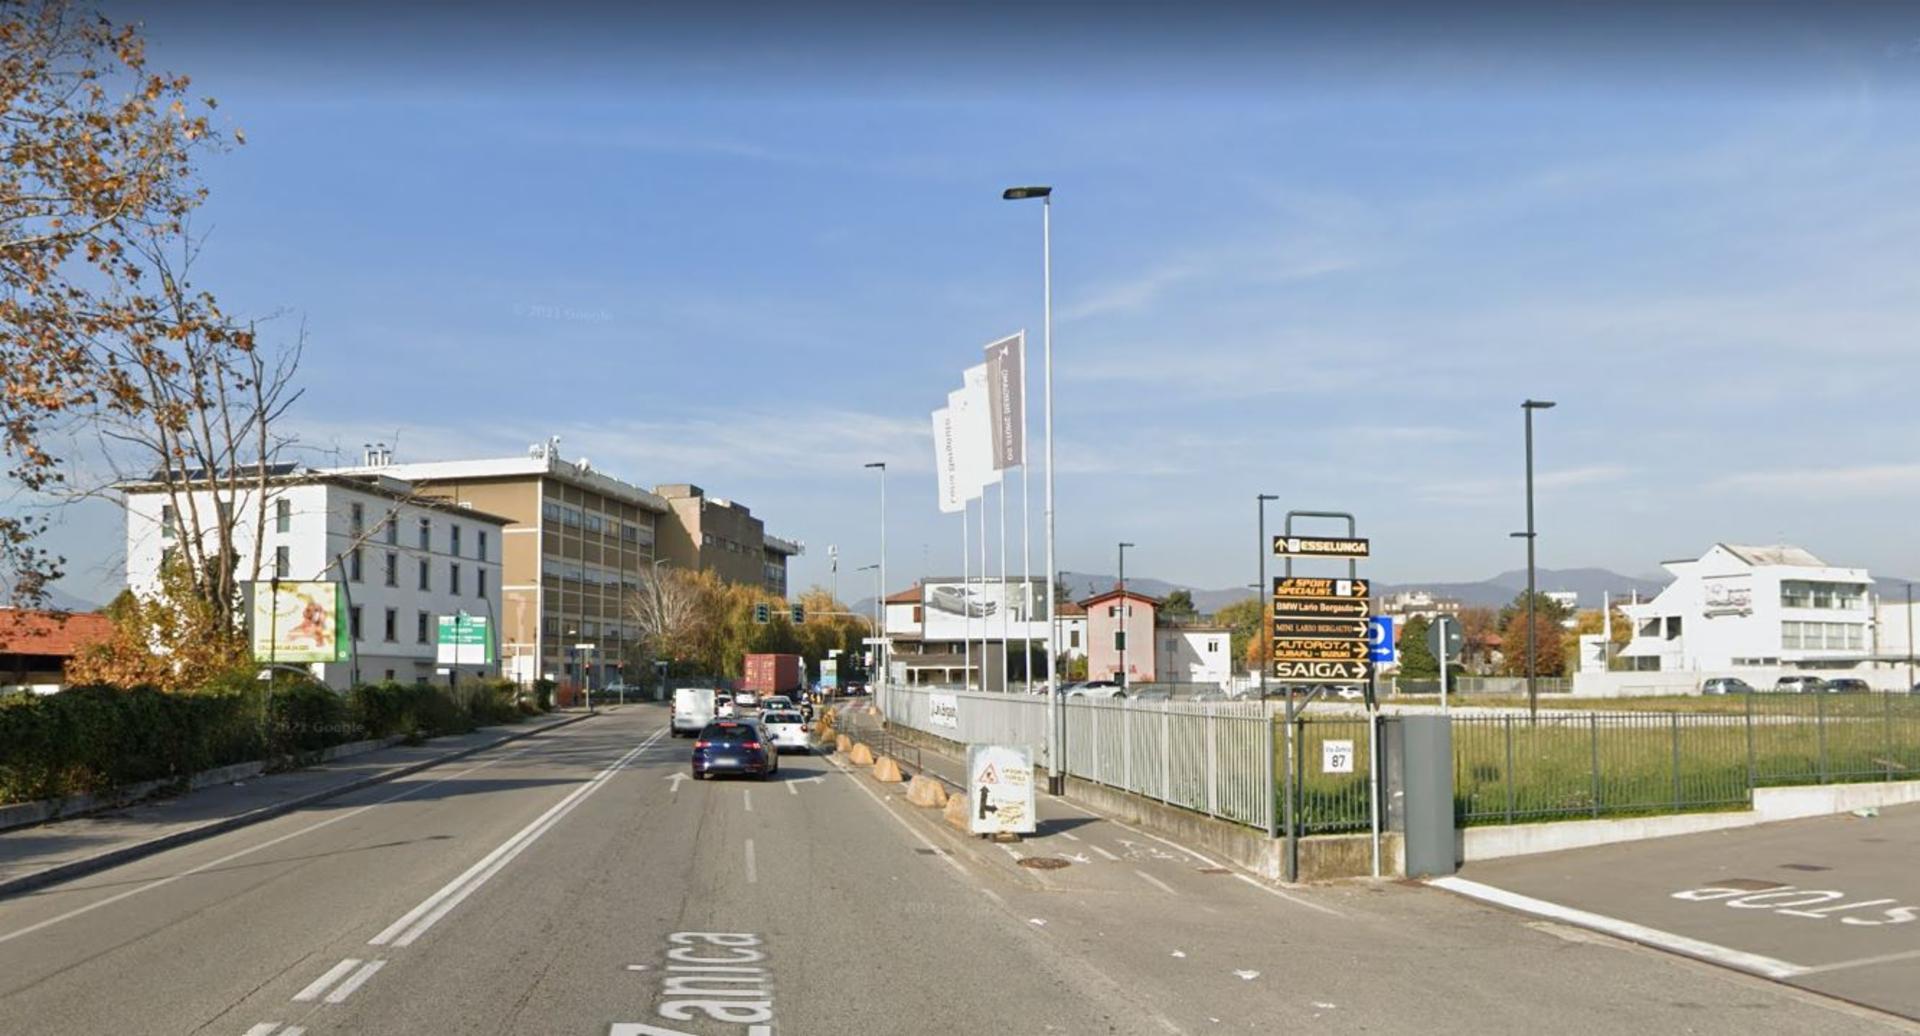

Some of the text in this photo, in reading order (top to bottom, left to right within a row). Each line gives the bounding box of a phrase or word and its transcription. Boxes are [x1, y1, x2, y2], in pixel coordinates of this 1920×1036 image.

[1301, 541, 1367, 552] ESSELUNGA
[1296, 579, 1332, 588] SPORT
[1276, 602, 1297, 610] BMW
[1277, 641, 1350, 649] AUTOROTA
[1275, 650, 1313, 658] SUBARU
[1321, 650, 1350, 658] SUZUKI
[1277, 662, 1348, 677] SAIGA
[1332, 755, 1345, 768] 87
[1669, 886, 1920, 926] STOP
